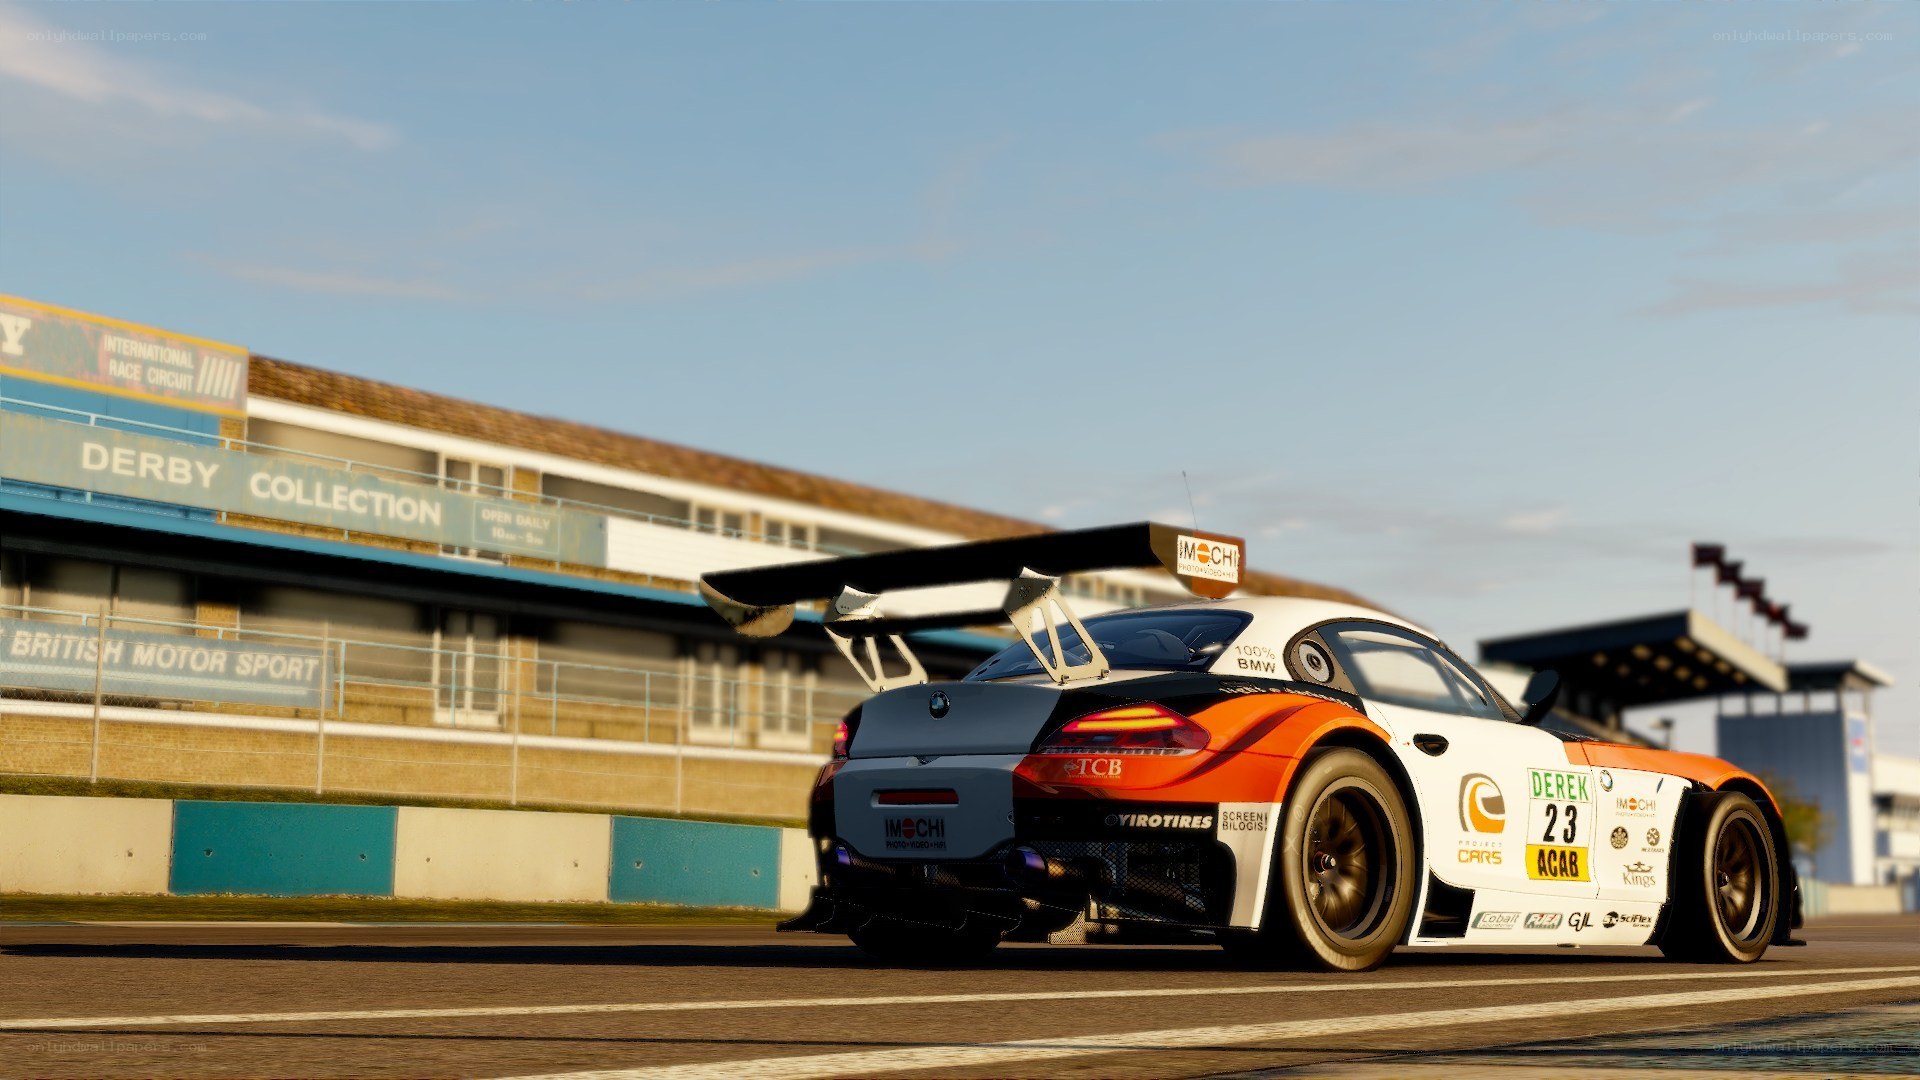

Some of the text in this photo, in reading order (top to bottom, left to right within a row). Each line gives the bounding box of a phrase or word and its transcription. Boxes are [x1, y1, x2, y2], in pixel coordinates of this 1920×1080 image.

[103, 334, 195, 370] INTERNATIONAL
[109, 358, 195, 392] RACE CIRCUIT
[80, 442, 442, 527] DERBY COLLECTION
[481, 508, 551, 531] OPEN DAILY
[1178, 540, 1240, 569] IMOCHI
[9, 629, 320, 682] BRITISH MOTOR SPORT
[1234, 645, 1277, 660] 100%
[1237, 658, 1277, 674] BMW
[1076, 758, 1122, 776] TCB
[1531, 771, 1590, 801] DEREK
[1616, 798, 1656, 811] IMOCHI
[885, 818, 945, 838] IMOCHI
[1542, 803, 1578, 844] 23
[1457, 849, 1503, 865] CARS
[1537, 849, 1580, 877] ACAB
[1622, 872, 1656, 888] Kings
[1481, 913, 1520, 924] Cobalt
